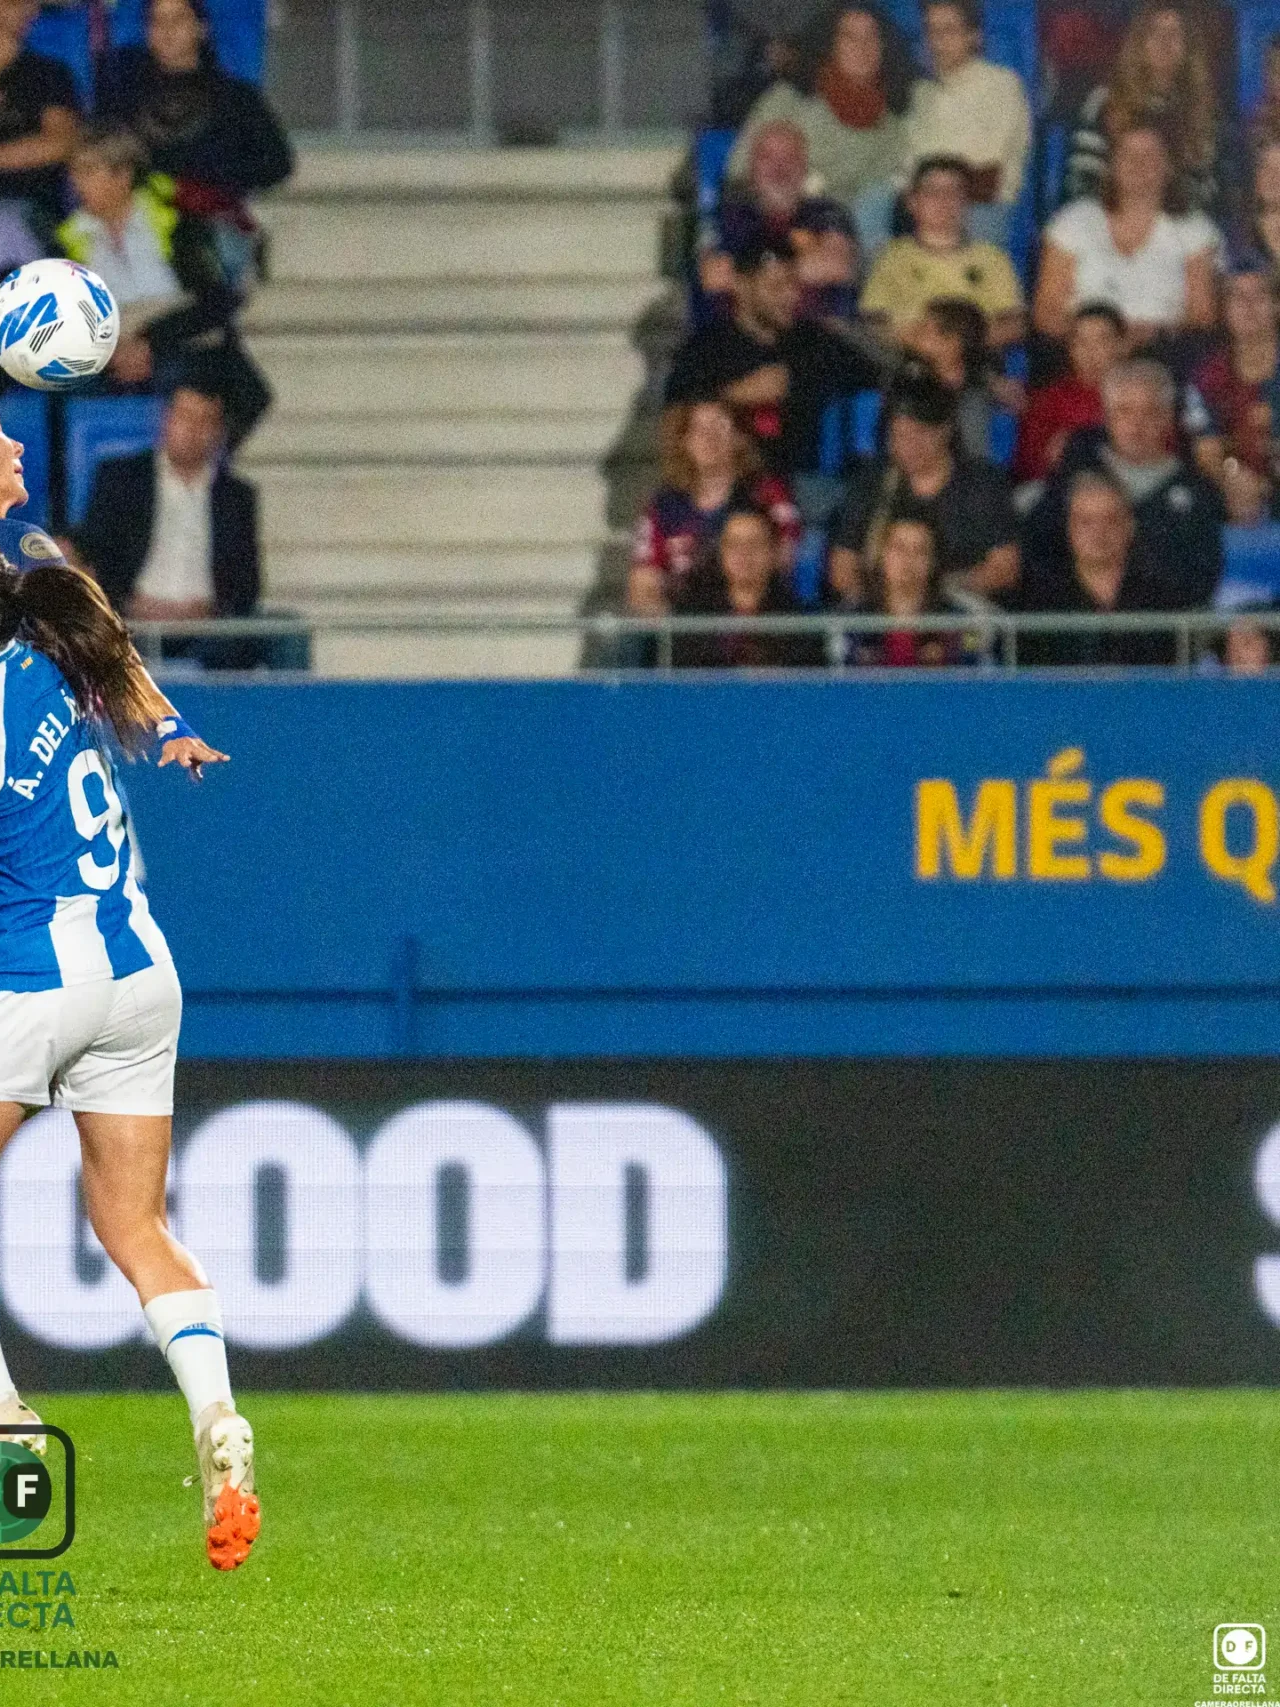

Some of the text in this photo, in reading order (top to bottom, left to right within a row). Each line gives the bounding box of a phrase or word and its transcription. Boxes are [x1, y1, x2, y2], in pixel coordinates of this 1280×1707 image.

[7, 711, 70, 801] Á. DEL
[915, 746, 1167, 880] MÉS
